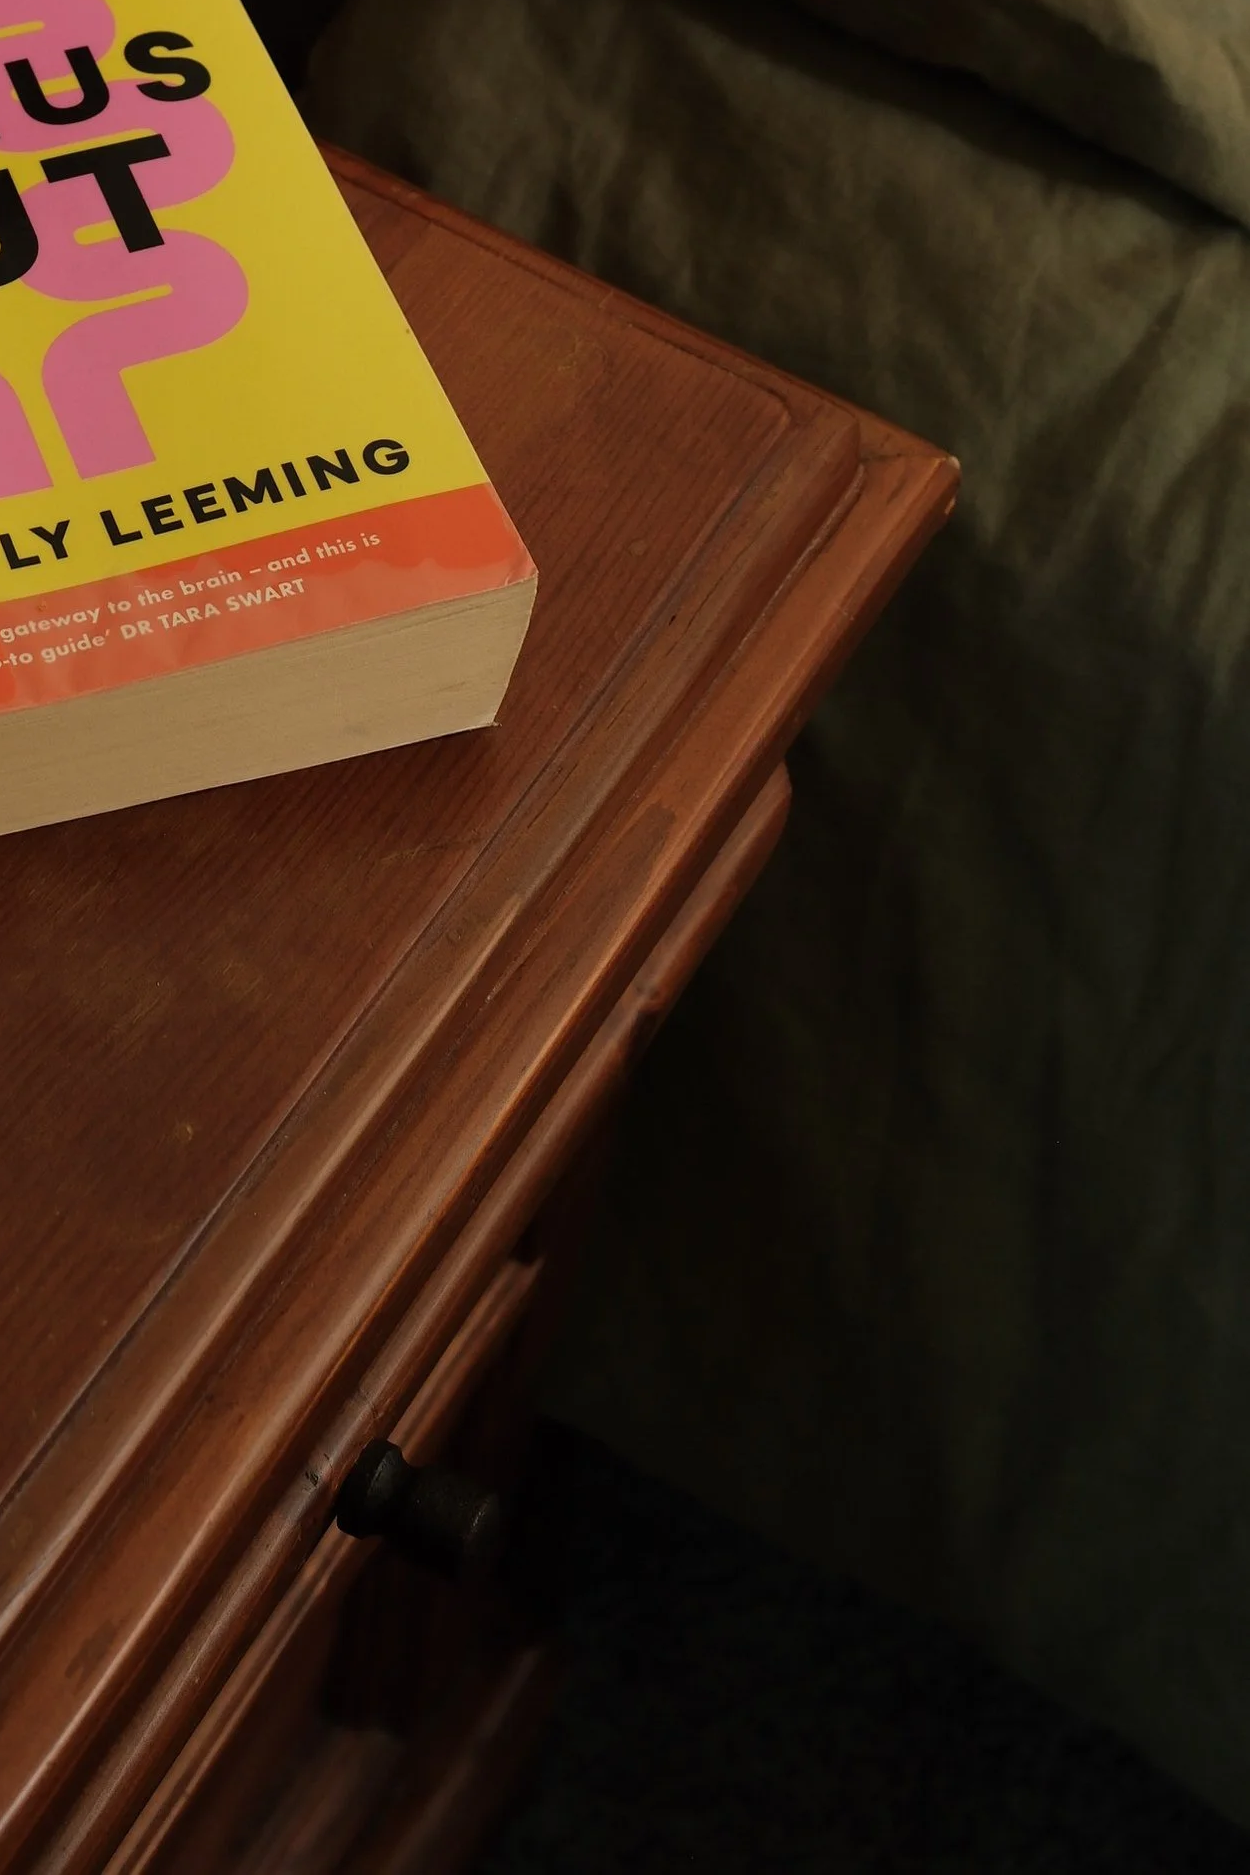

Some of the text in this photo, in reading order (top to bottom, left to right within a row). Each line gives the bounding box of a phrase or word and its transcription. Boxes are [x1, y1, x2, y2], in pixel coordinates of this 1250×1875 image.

[99, 438, 411, 547] LEEMING
[0, 607, 100, 643] gateway
[107, 598, 132, 615] to
[137, 589, 175, 607] the
[179, 569, 243, 596] brain
[267, 548, 311, 573] and
[315, 538, 357, 560] this
[363, 532, 382, 548] is
[120, 620, 154, 641] DR
[157, 602, 221, 631] TARA
[225, 578, 305, 613] SWART
